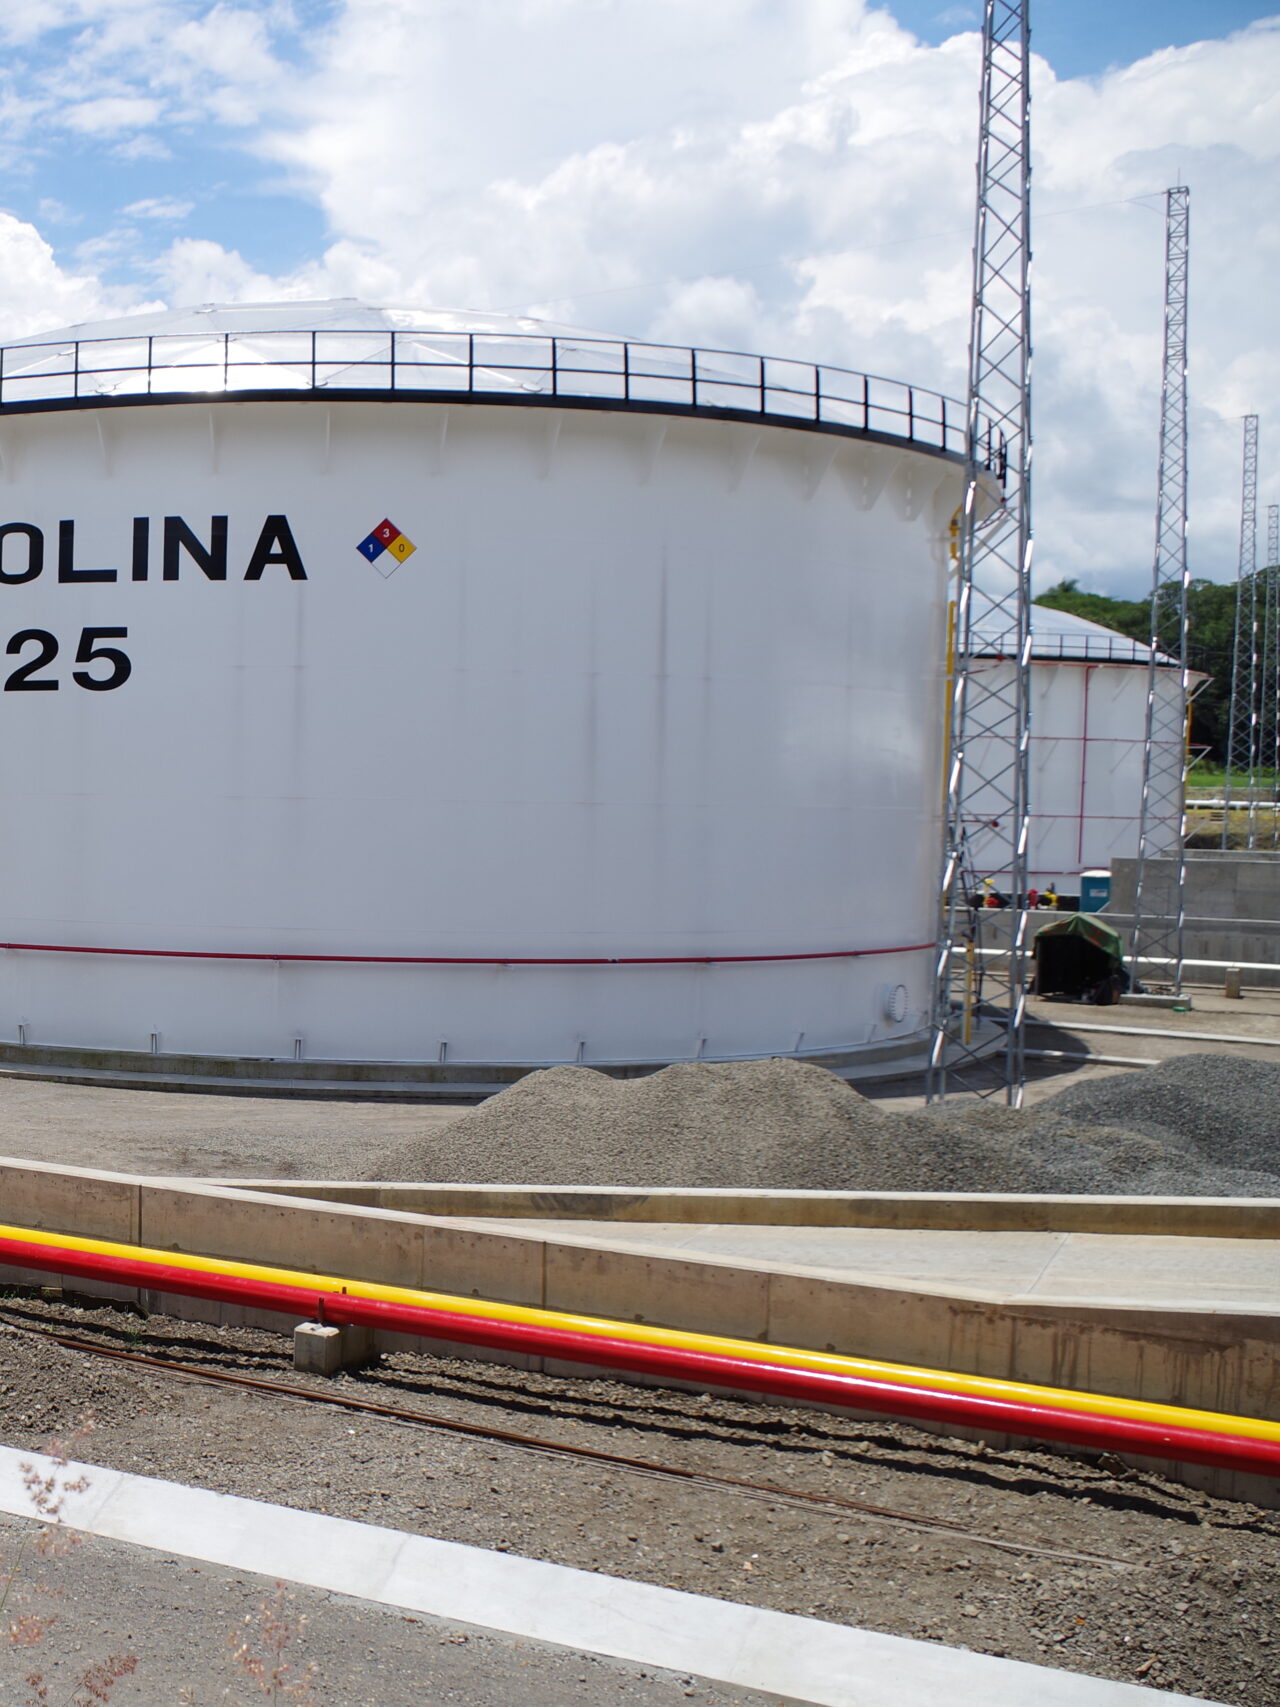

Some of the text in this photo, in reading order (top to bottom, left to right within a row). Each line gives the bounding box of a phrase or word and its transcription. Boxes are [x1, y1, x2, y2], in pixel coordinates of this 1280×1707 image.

[383, 528, 390, 538] 3
[368, 543, 374, 553] 1
[398, 543, 405, 553] 0
